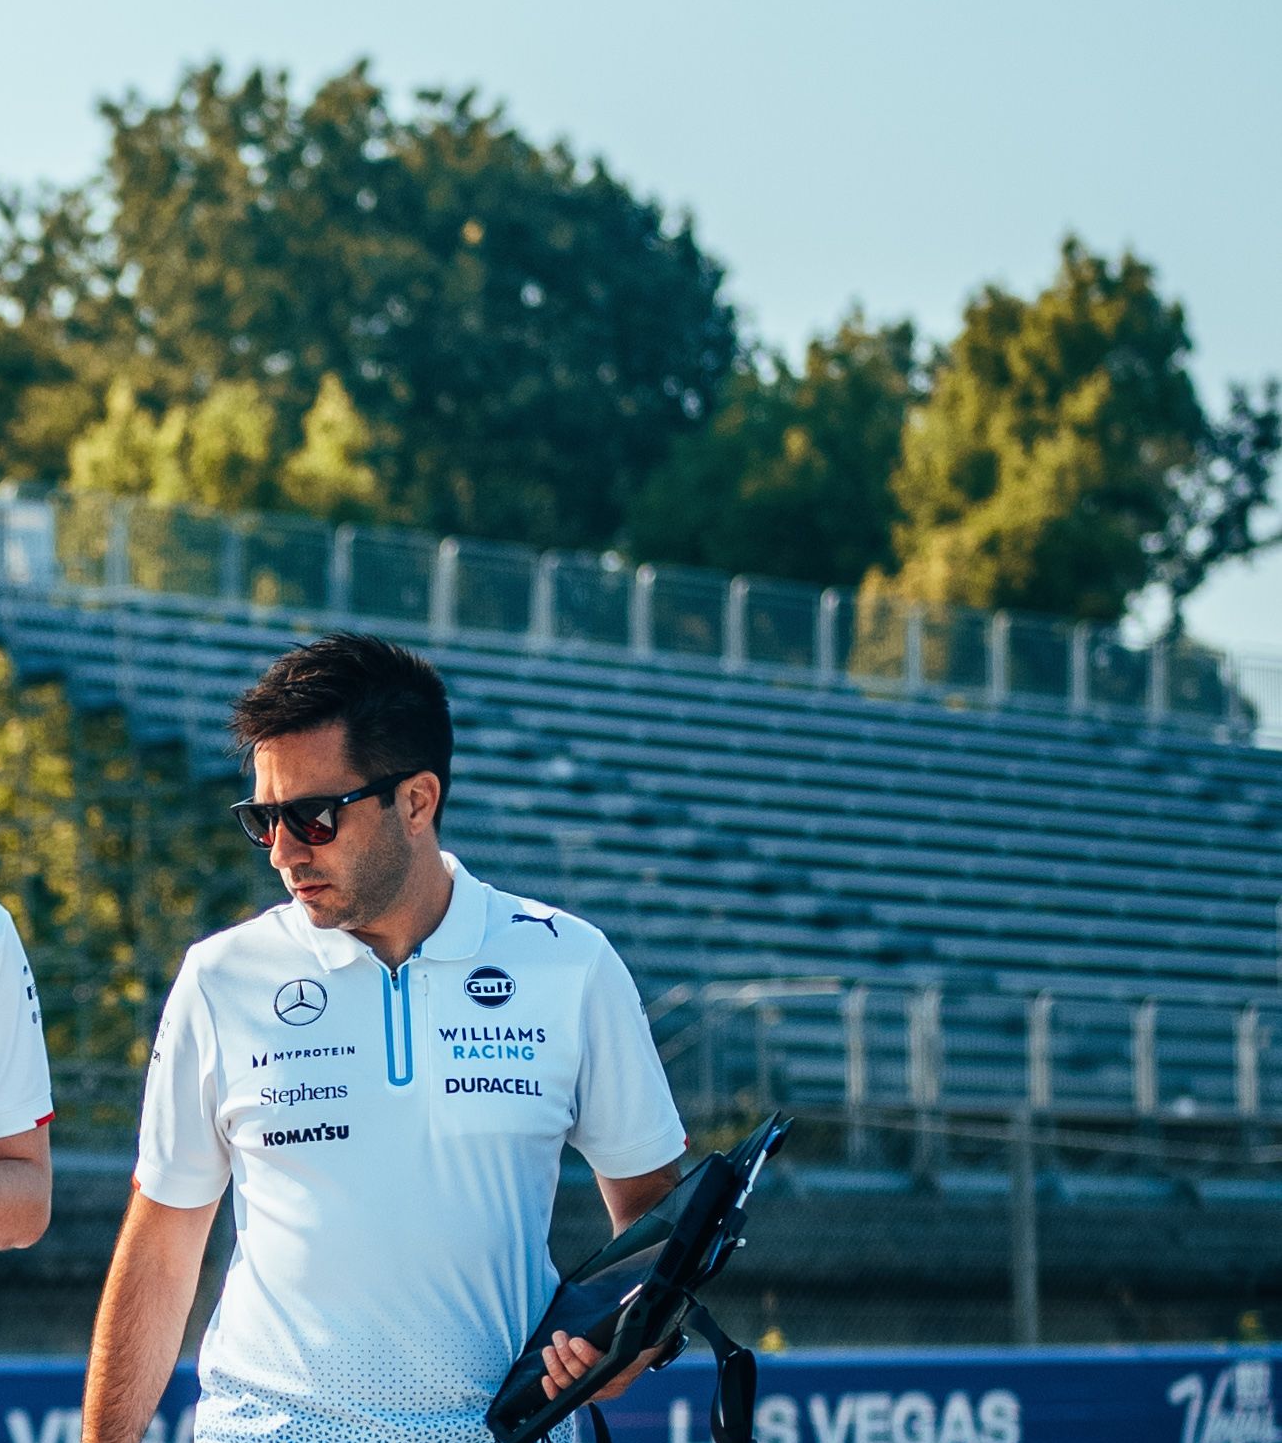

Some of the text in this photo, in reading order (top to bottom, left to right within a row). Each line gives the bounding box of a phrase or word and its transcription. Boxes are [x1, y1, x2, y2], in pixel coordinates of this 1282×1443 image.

[466, 980, 513, 994] Gulf
[438, 1026, 546, 1044] WILLIAMS
[273, 1045, 355, 1062] MYPROTEIN
[452, 1044, 535, 1061] RACING
[259, 1082, 348, 1107] Stephens
[445, 1077, 543, 1097] DURACELL
[262, 1122, 350, 1147] KOMATSU
